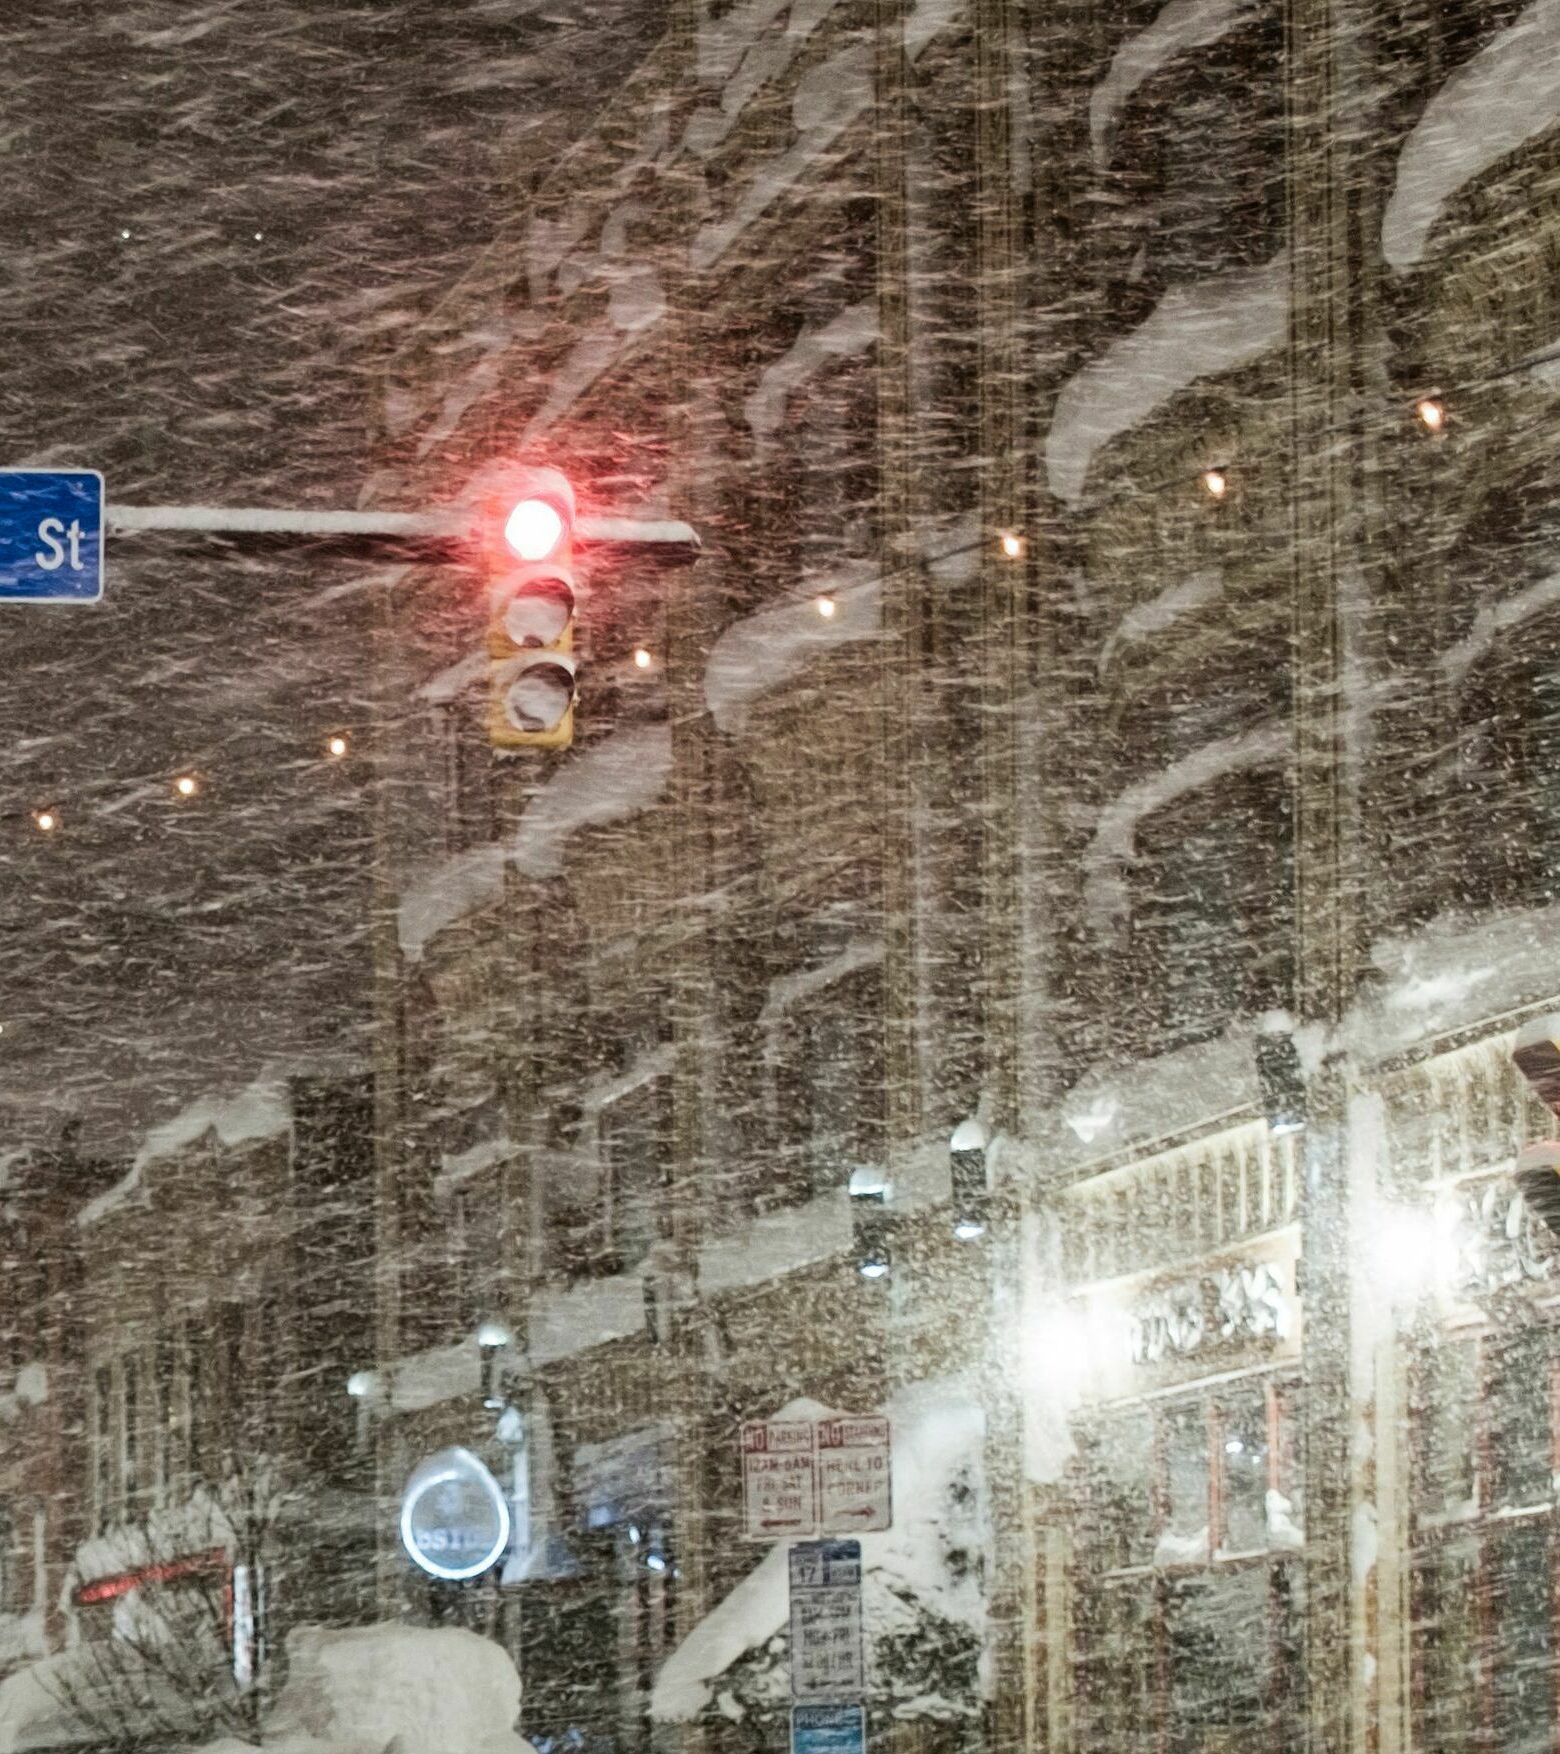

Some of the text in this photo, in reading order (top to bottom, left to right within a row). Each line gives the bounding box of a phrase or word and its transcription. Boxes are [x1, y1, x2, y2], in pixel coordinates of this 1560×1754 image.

[35, 517, 86, 571] St
[744, 1426, 810, 1449] NO PARKING
[819, 1423, 842, 1446] NO
[826, 1456, 883, 1473] HERE TO
